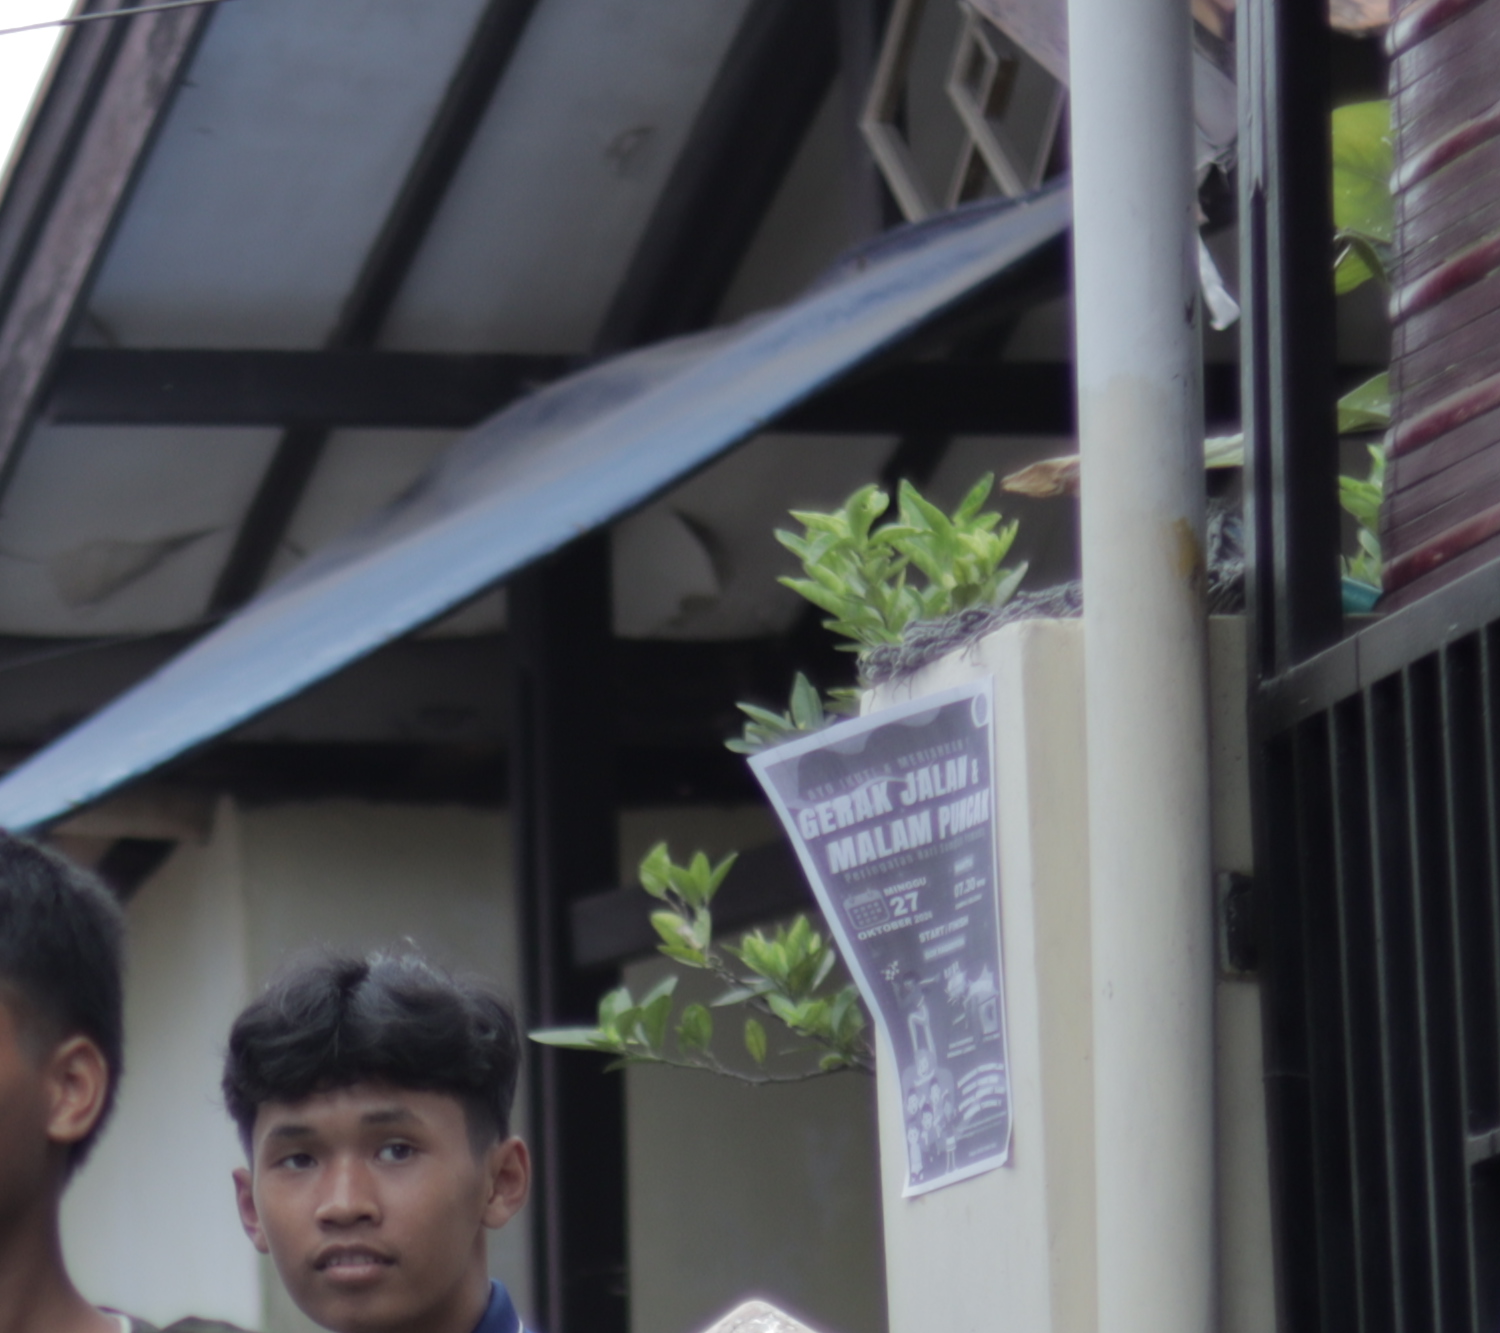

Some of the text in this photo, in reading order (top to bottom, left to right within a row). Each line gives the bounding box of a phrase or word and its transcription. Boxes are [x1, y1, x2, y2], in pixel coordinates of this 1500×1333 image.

[798, 781, 893, 840] GERAK
[899, 754, 968, 806] JALAN
[826, 788, 989, 875] MALAM PUNCAK
[883, 877, 927, 897] MINGGU
[889, 891, 919, 917] 27
[857, 917, 912, 941] OKTOBER
